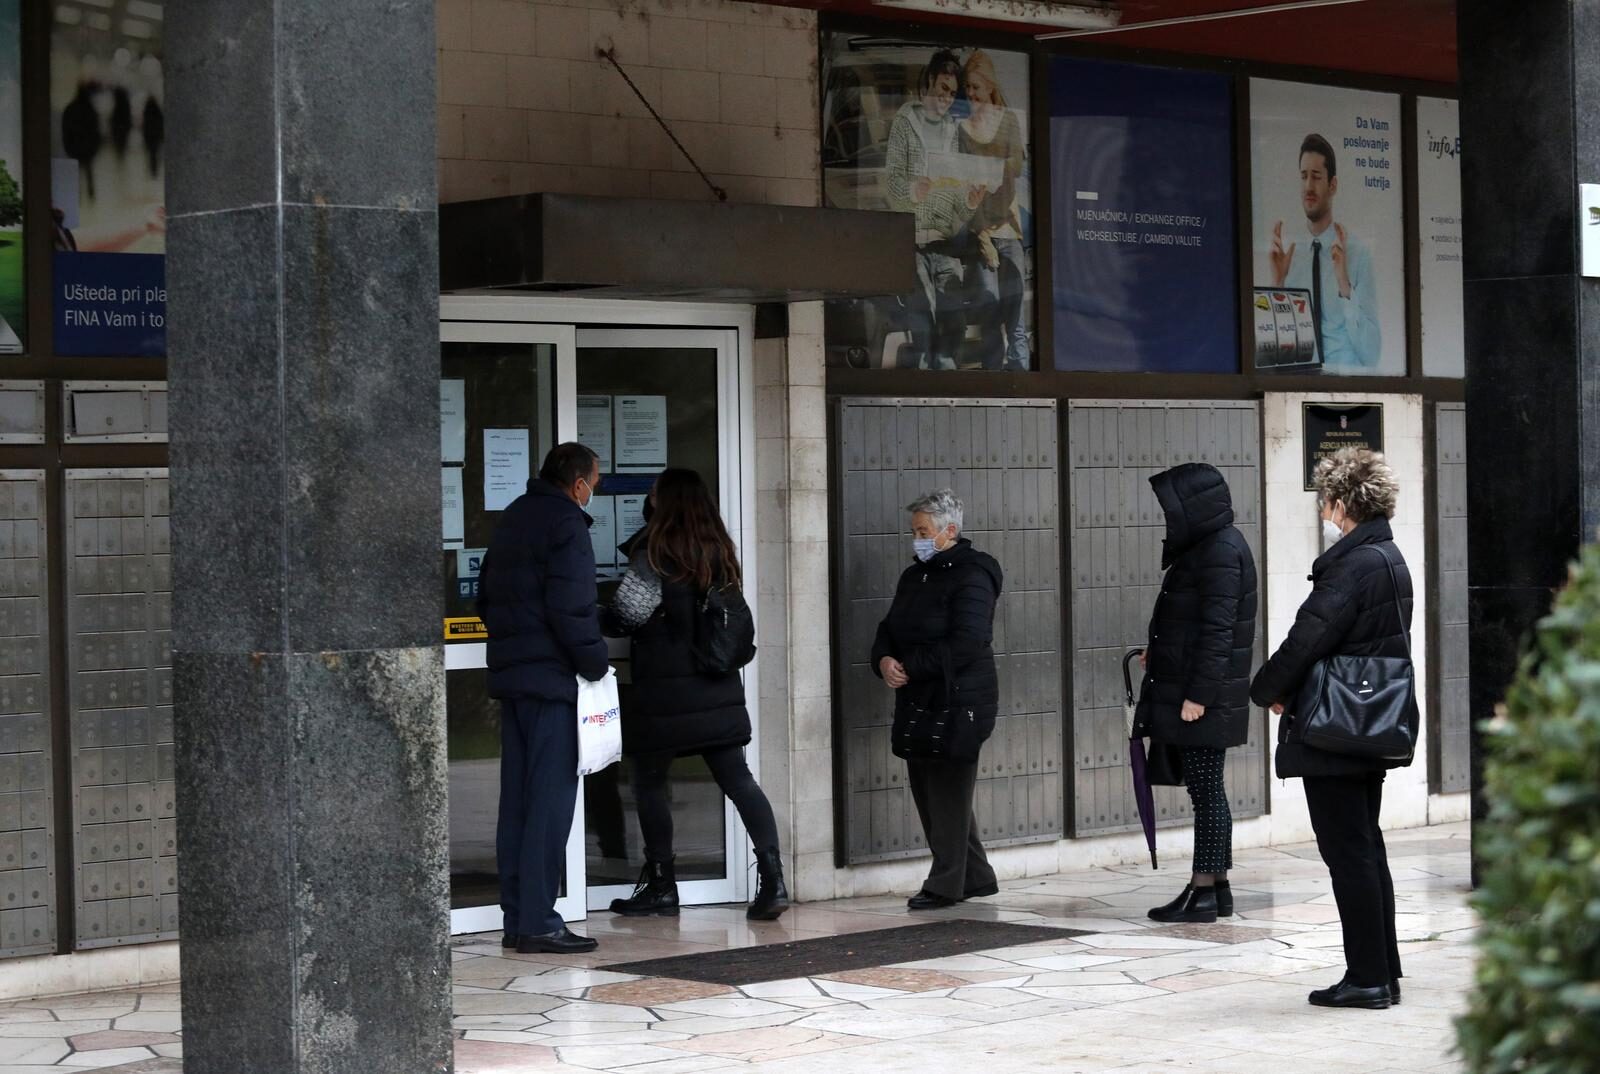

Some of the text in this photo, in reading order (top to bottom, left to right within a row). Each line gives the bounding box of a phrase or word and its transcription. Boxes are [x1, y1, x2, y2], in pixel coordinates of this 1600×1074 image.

[1356, 116, 1389, 131] Da Vam
[1343, 136, 1390, 150] poslovanje
[1355, 156, 1390, 169] ne bude
[1364, 175, 1390, 191] lutrija
[1076, 208, 1128, 221] MJENJAČNICA
[1135, 212, 1174, 225] EXCHANGE
[1175, 215, 1201, 227] OFFICE
[1077, 230, 1137, 243] WECHSELSTUBE
[1144, 233, 1174, 245] CAMBIO
[1174, 235, 1201, 247] VALUTE
[64, 284, 168, 304] Ušteda pri pla
[64, 310, 164, 328] FINA Vam i to
